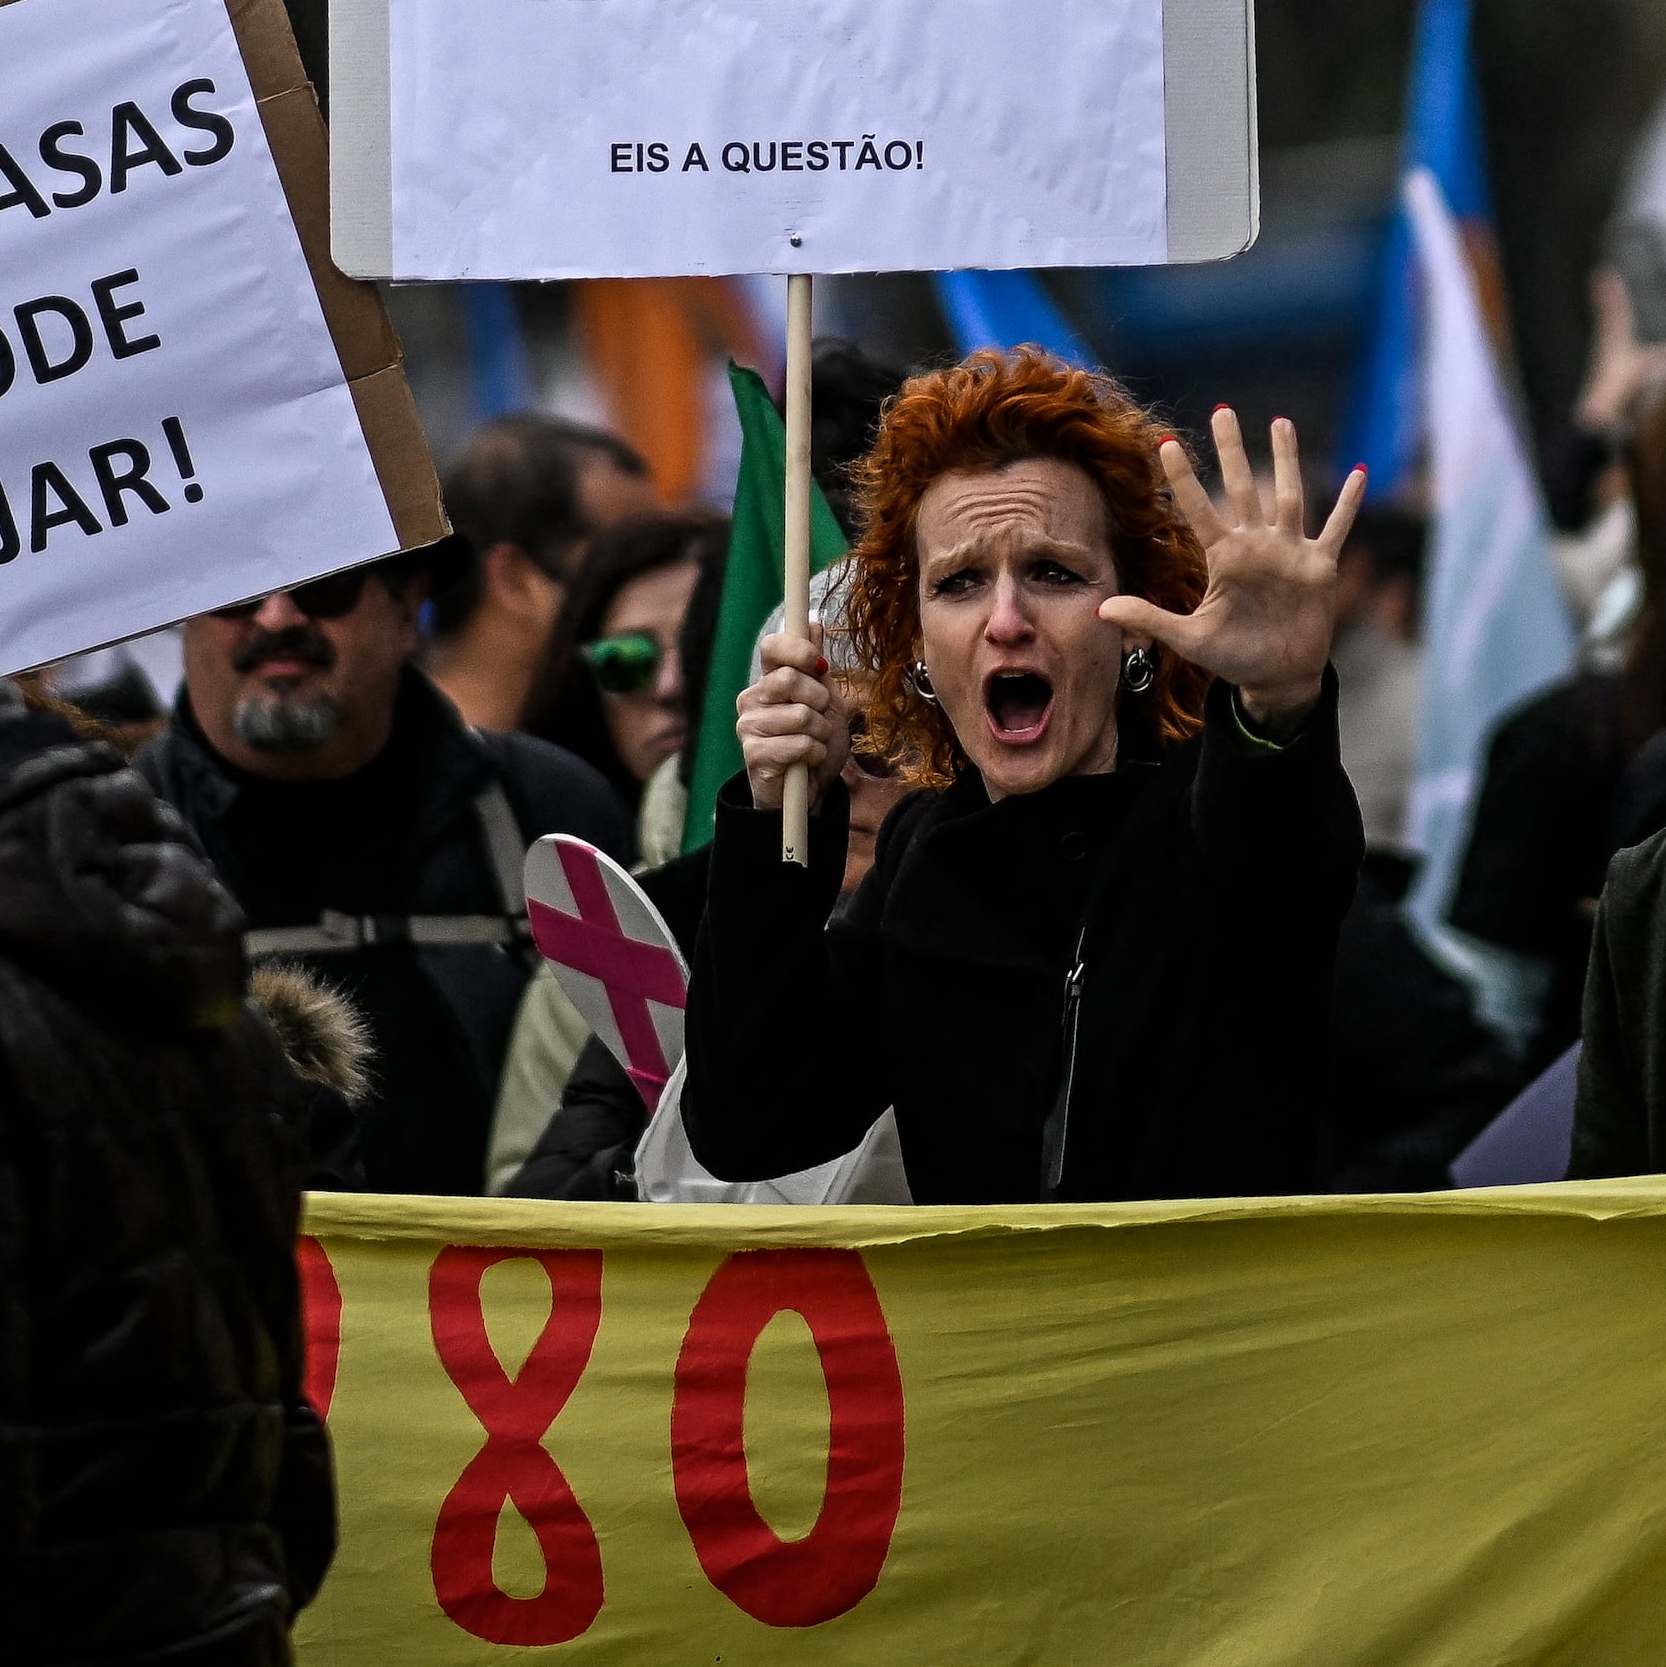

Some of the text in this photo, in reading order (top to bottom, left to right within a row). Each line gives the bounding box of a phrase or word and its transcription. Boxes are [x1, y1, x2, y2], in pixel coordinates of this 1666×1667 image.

[611, 133, 924, 174] EIS A QUESTÃO!
